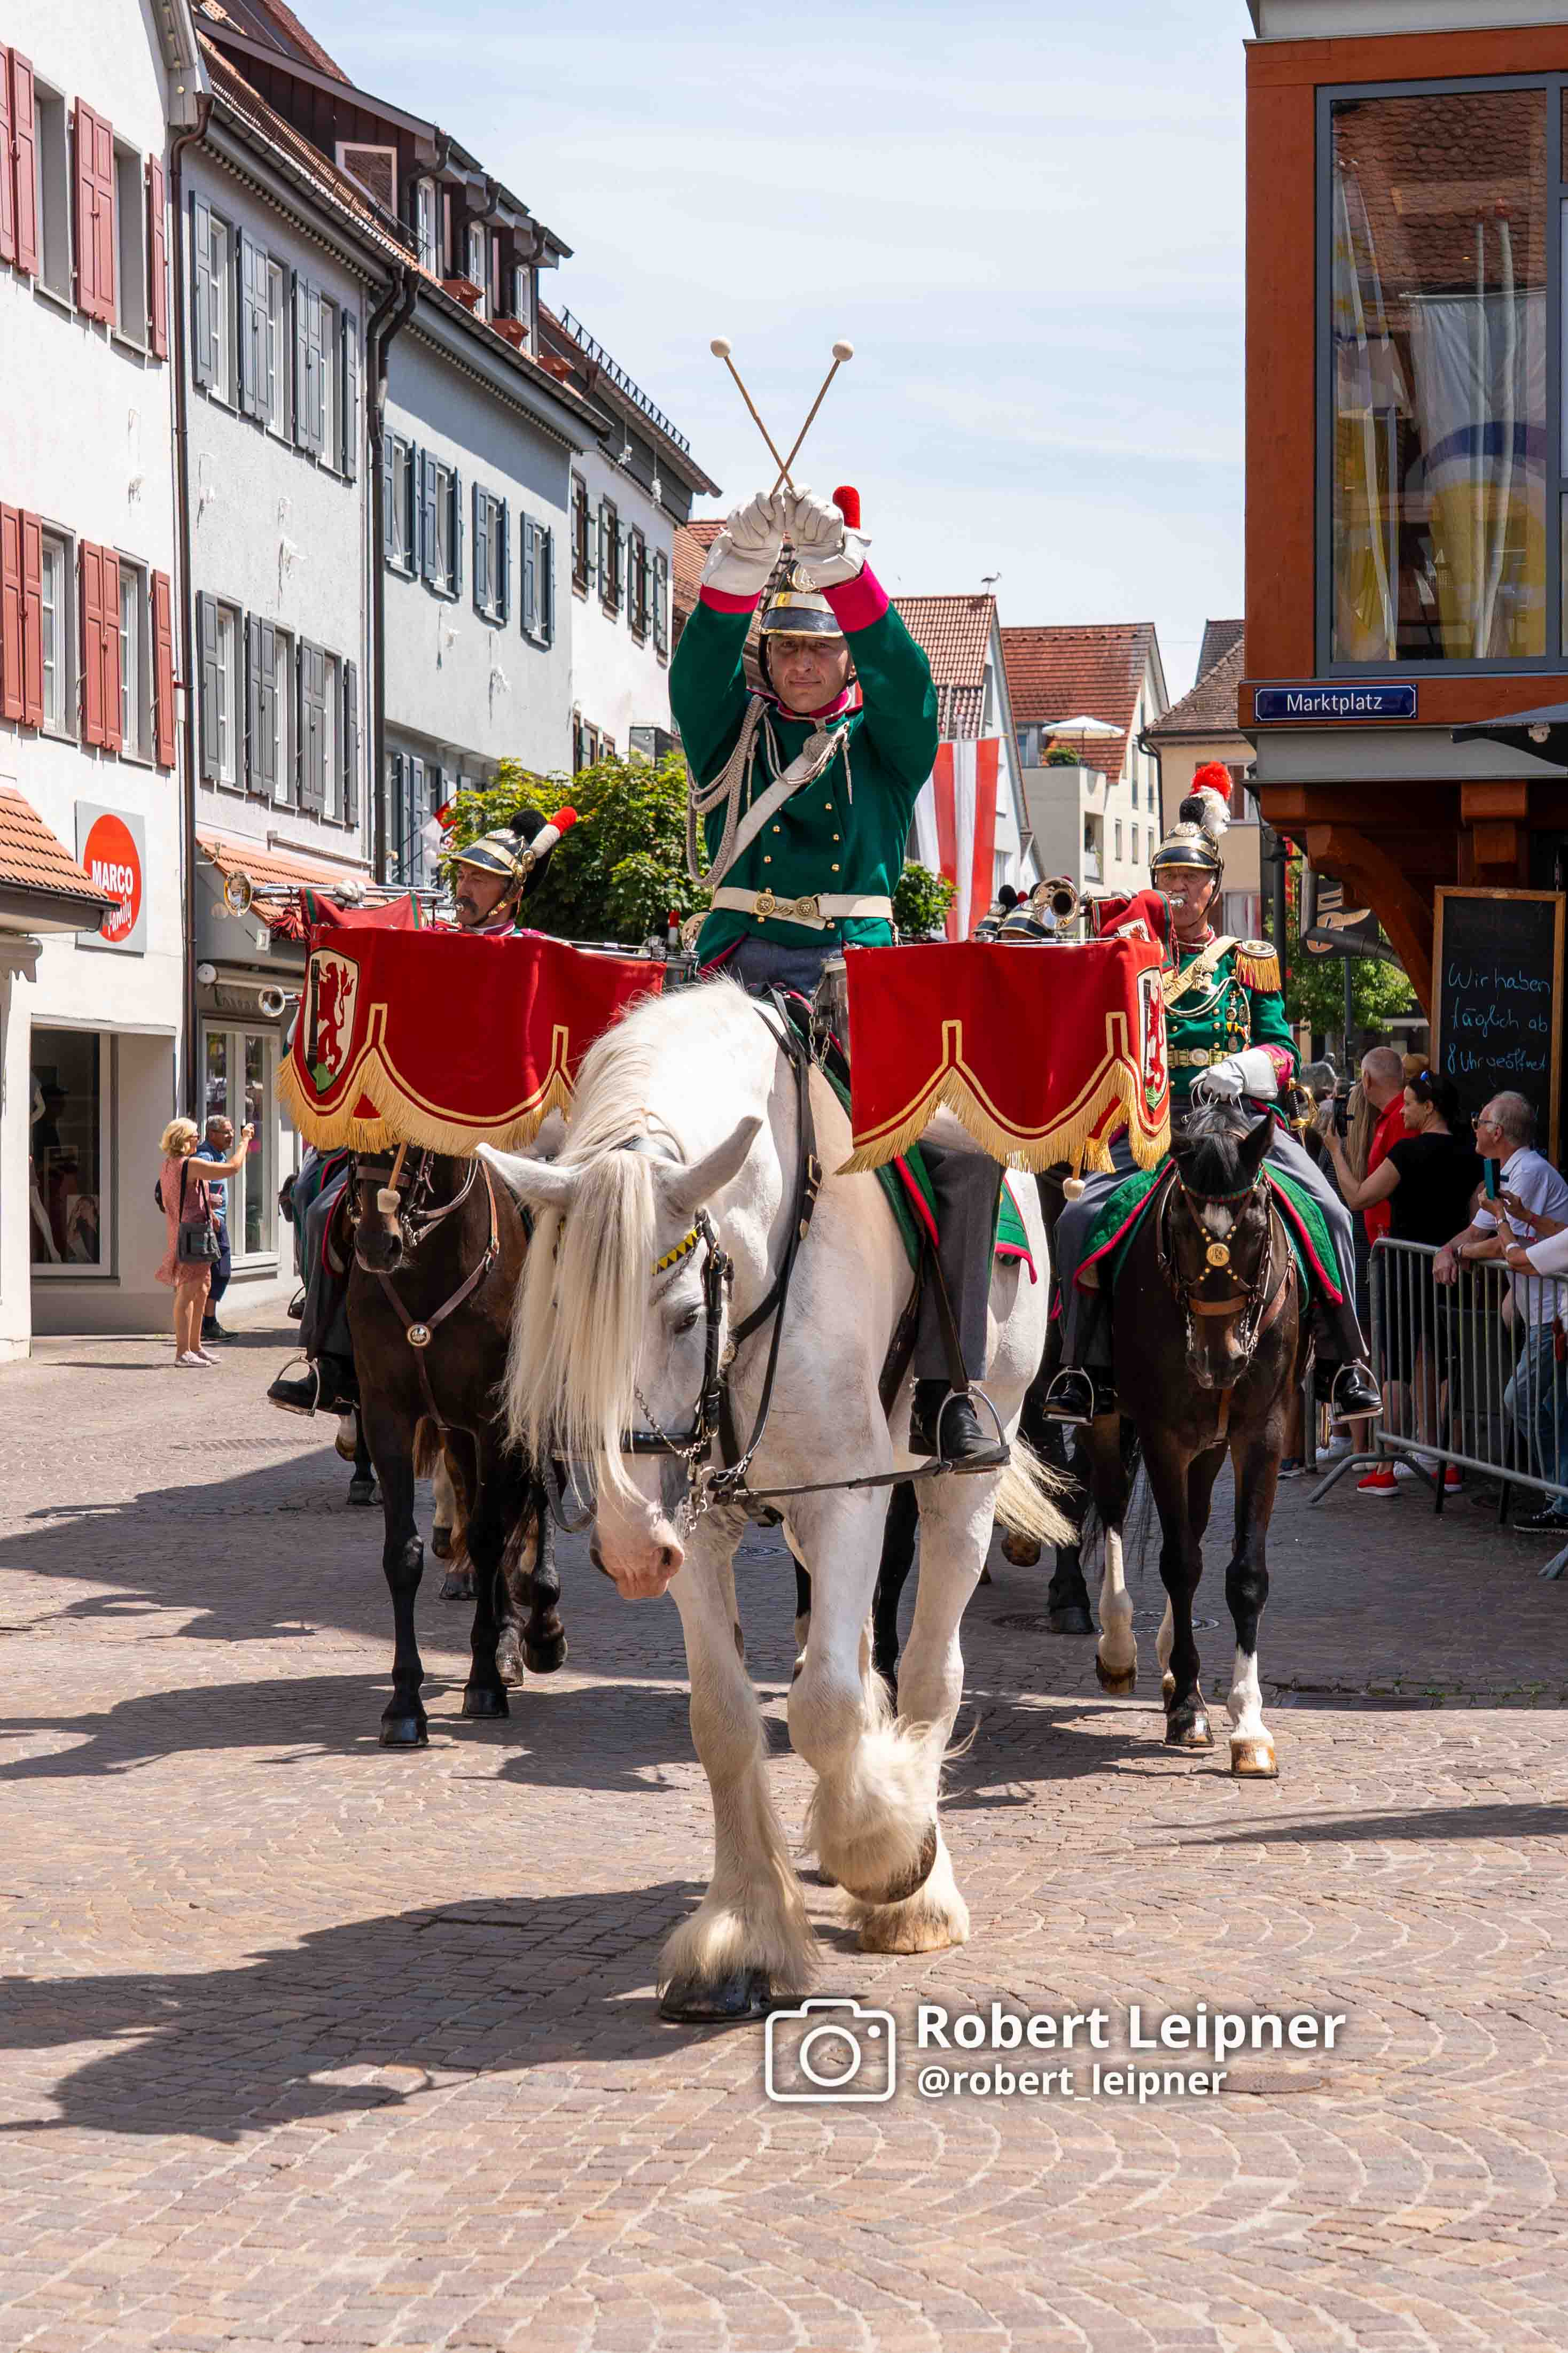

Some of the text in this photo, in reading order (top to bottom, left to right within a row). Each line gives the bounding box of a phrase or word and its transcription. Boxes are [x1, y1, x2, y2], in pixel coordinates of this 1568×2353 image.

[1287, 693, 1383, 715] Marktplatz
[92, 859, 133, 895] MARCO
[108, 893, 132, 937] amily
[1448, 962, 1550, 994] Wir haben
[1451, 996, 1548, 1037] täglich ab
[1447, 1043, 1457, 1075] 8
